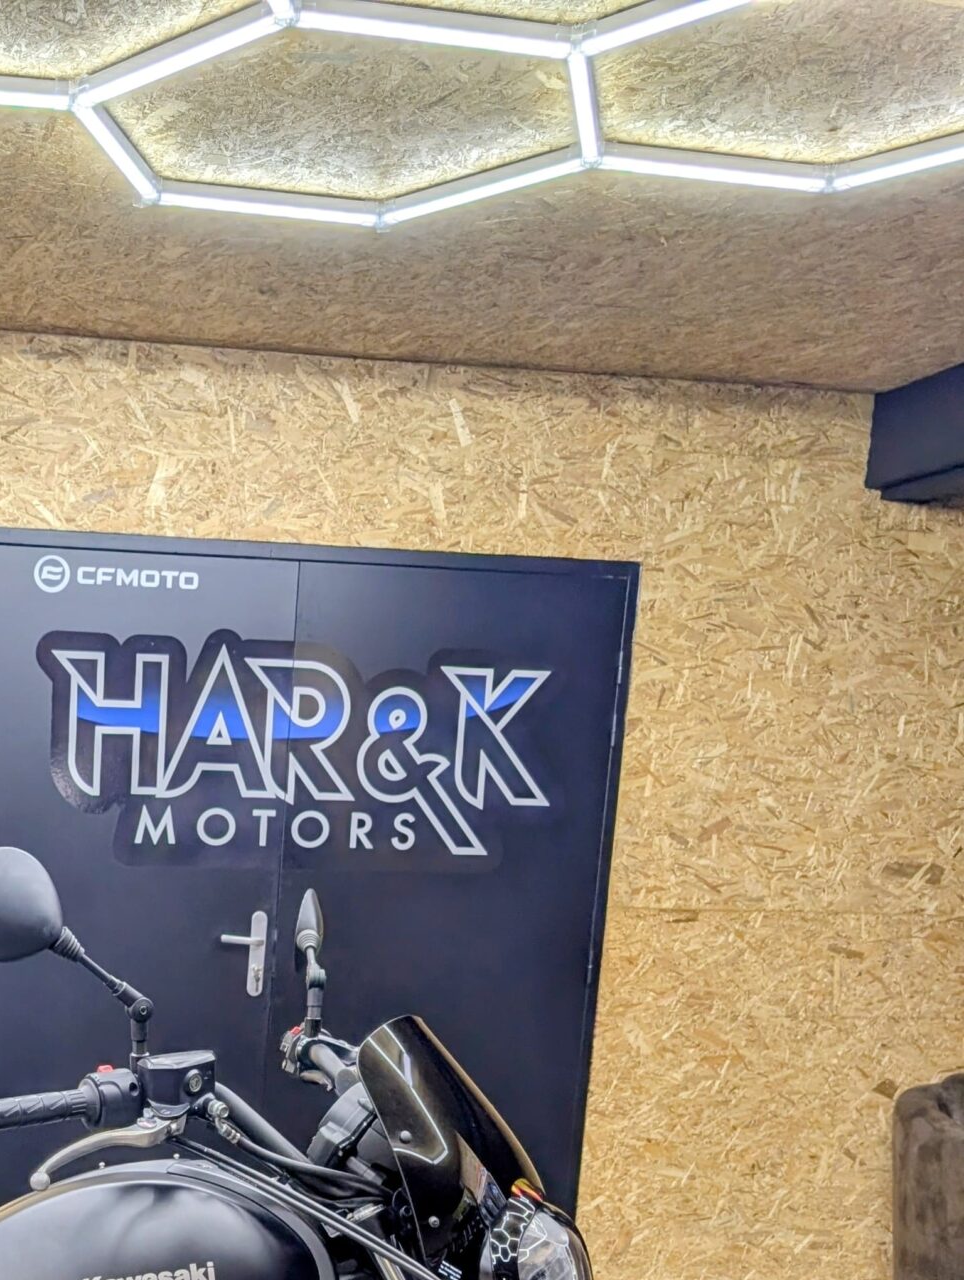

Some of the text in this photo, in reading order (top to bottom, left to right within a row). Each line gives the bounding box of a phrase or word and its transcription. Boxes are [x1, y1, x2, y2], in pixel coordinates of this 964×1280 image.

[76, 565, 200, 590] CFMOTO
[50, 643, 553, 856] HAR&K
[133, 803, 416, 850] MOTORS
